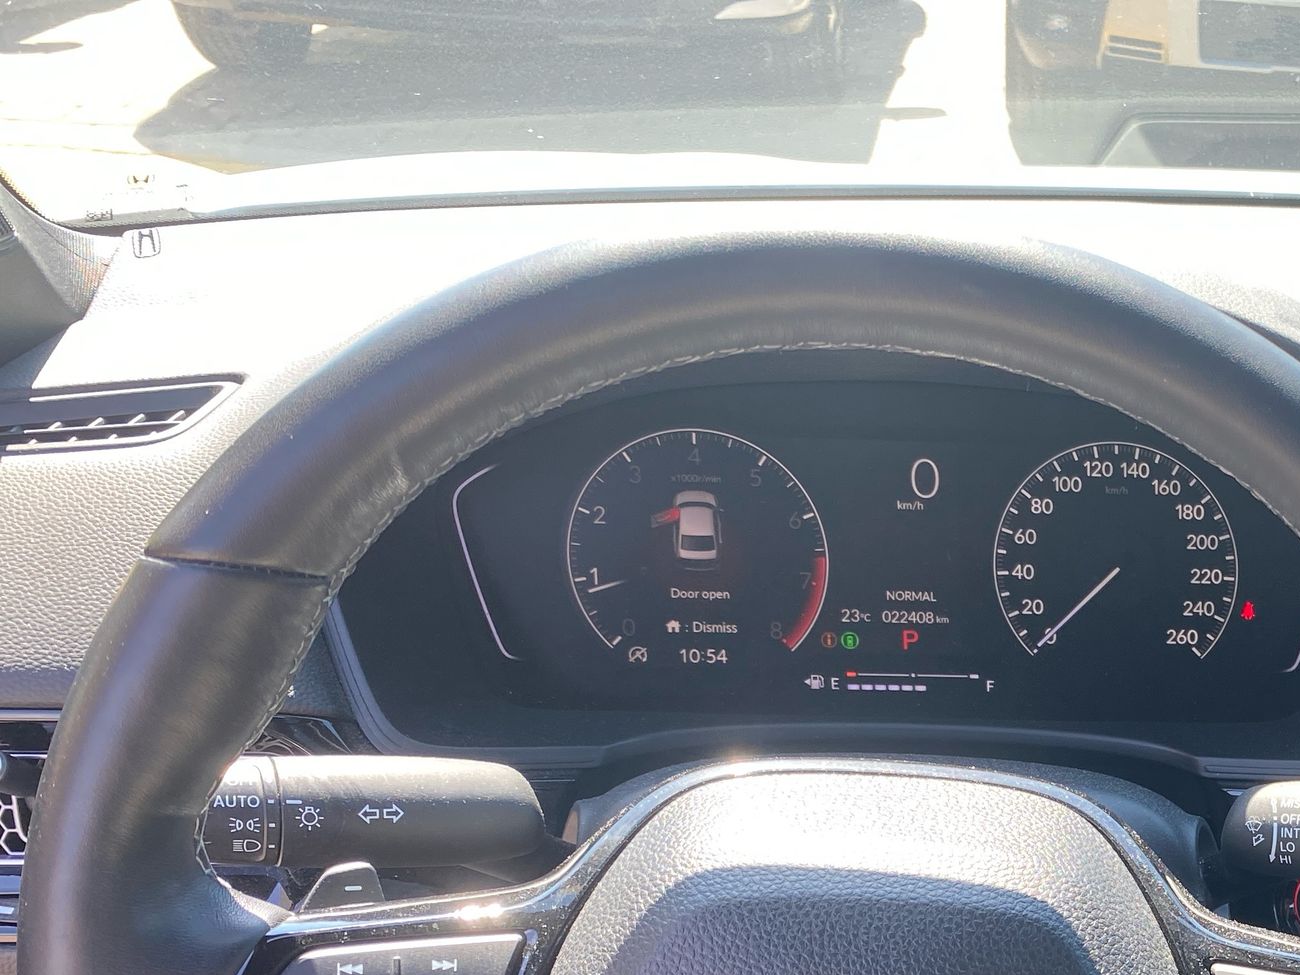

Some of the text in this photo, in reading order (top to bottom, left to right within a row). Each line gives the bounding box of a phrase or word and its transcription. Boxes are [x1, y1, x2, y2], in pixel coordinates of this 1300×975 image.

[688, 448, 701, 465] 4
[629, 466, 641, 483] 3
[1084, 461, 1114, 478] 120
[1120, 462, 1150, 479] 140
[750, 470, 761, 487] 5
[911, 458, 940, 499] 0
[1052, 476, 1082, 493] 100
[1152, 479, 1181, 496] 160
[897, 500, 924, 511] km/h
[1030, 498, 1053, 515] 80
[1175, 504, 1204, 520] 180
[594, 506, 607, 525] 2
[789, 512, 801, 529] 6
[1014, 528, 1037, 545] 60
[1186, 534, 1218, 551] 200
[589, 568, 599, 584] 1
[1012, 564, 1034, 580] 40
[1190, 568, 1222, 585] 220
[800, 573, 811, 589] 7
[671, 588, 730, 601] Door open
[886, 590, 937, 602] NORMAL
[1022, 599, 1044, 615] 20
[1183, 601, 1215, 617] 240
[882, 610, 949, 624] 022408 km
[622, 618, 635, 636] 0
[692, 621, 738, 634] Dismiss
[770, 622, 783, 639] 8
[902, 630, 919, 650] P
[1166, 629, 1198, 645] 260
[679, 649, 728, 664] 10:54
[831, 677, 840, 690] E
[986, 680, 995, 692] F
[213, 795, 260, 808] AUTO
[1280, 827, 1300, 839] INT
[1280, 841, 1296, 853] LO
[1279, 854, 1292, 865] HI
